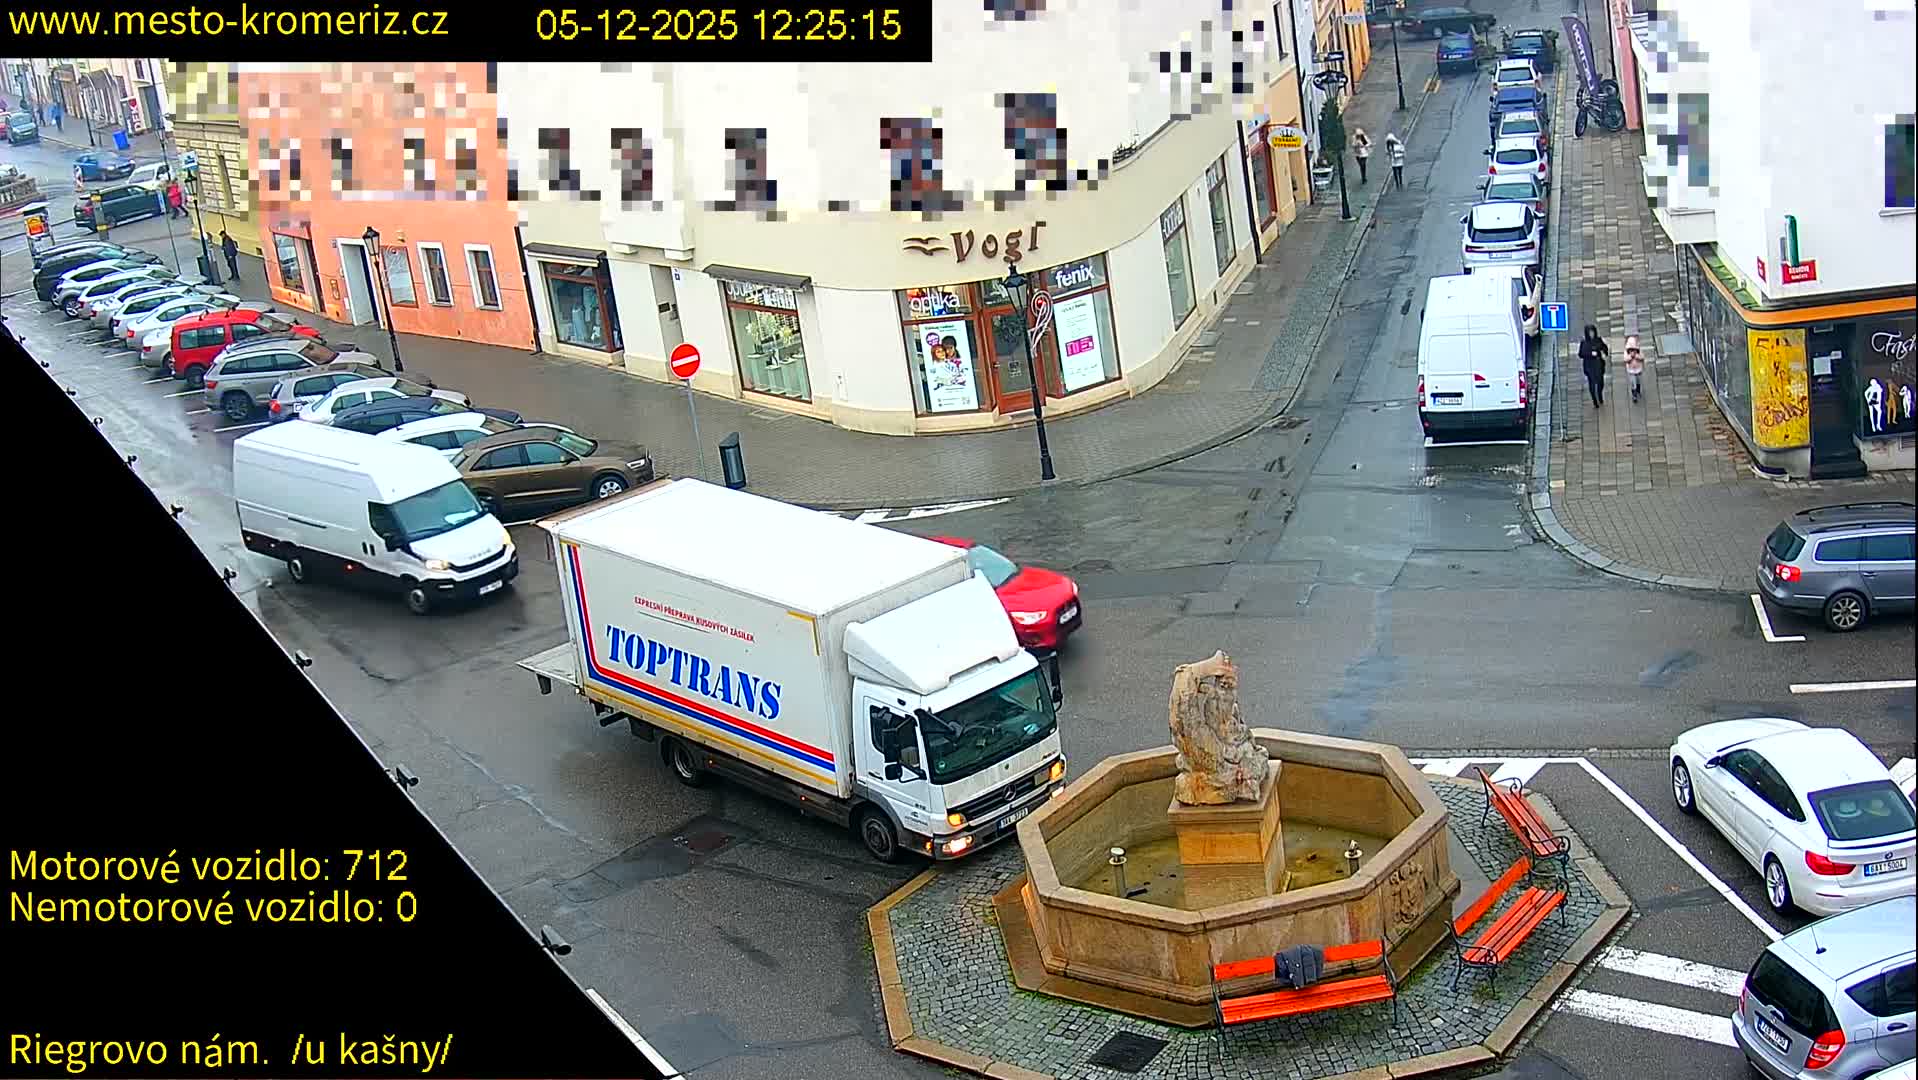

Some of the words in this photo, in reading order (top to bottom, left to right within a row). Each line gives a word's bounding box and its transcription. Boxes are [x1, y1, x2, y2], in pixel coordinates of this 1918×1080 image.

[1055, 264, 1096, 289] fenix
[911, 293, 961, 313] optika
[606, 625, 783, 721] TOPTRANS
